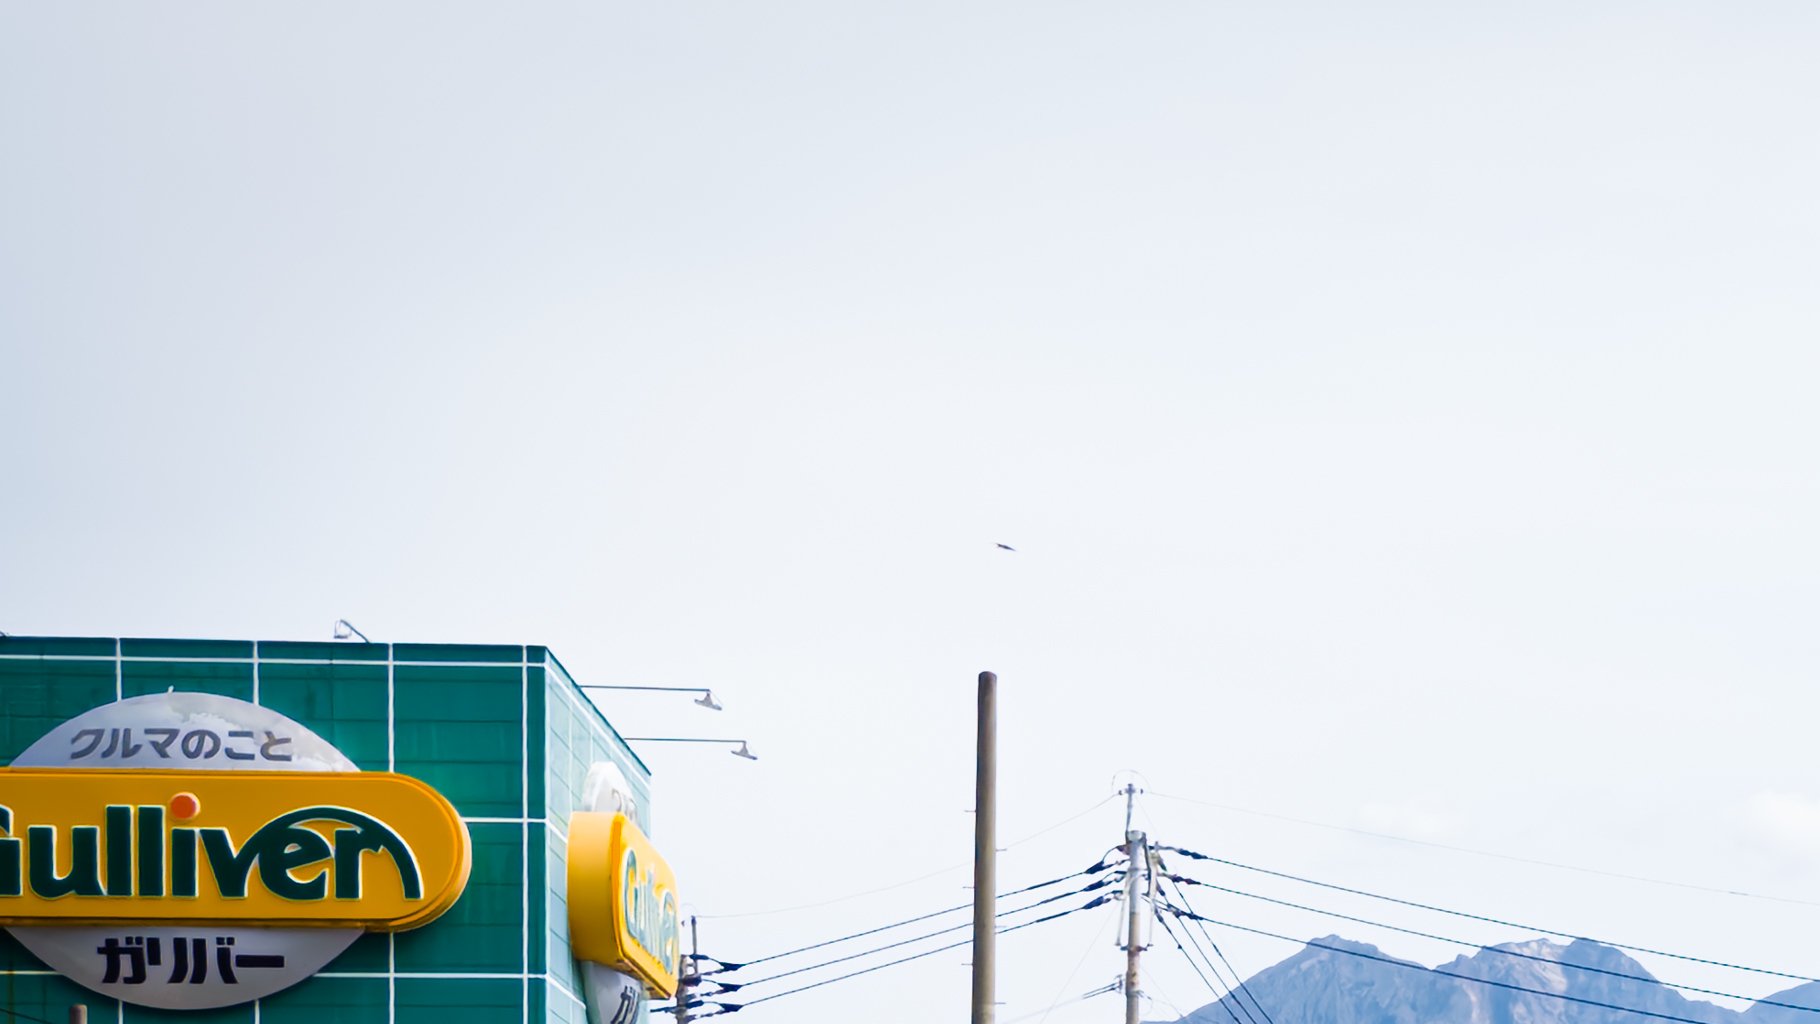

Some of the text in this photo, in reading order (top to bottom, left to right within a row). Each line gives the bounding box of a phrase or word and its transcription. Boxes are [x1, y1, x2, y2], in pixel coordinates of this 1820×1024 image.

[70, 727, 293, 762] クルマのこと
[0, 793, 423, 900] ulliver
[97, 936, 284, 985] ガリバー
